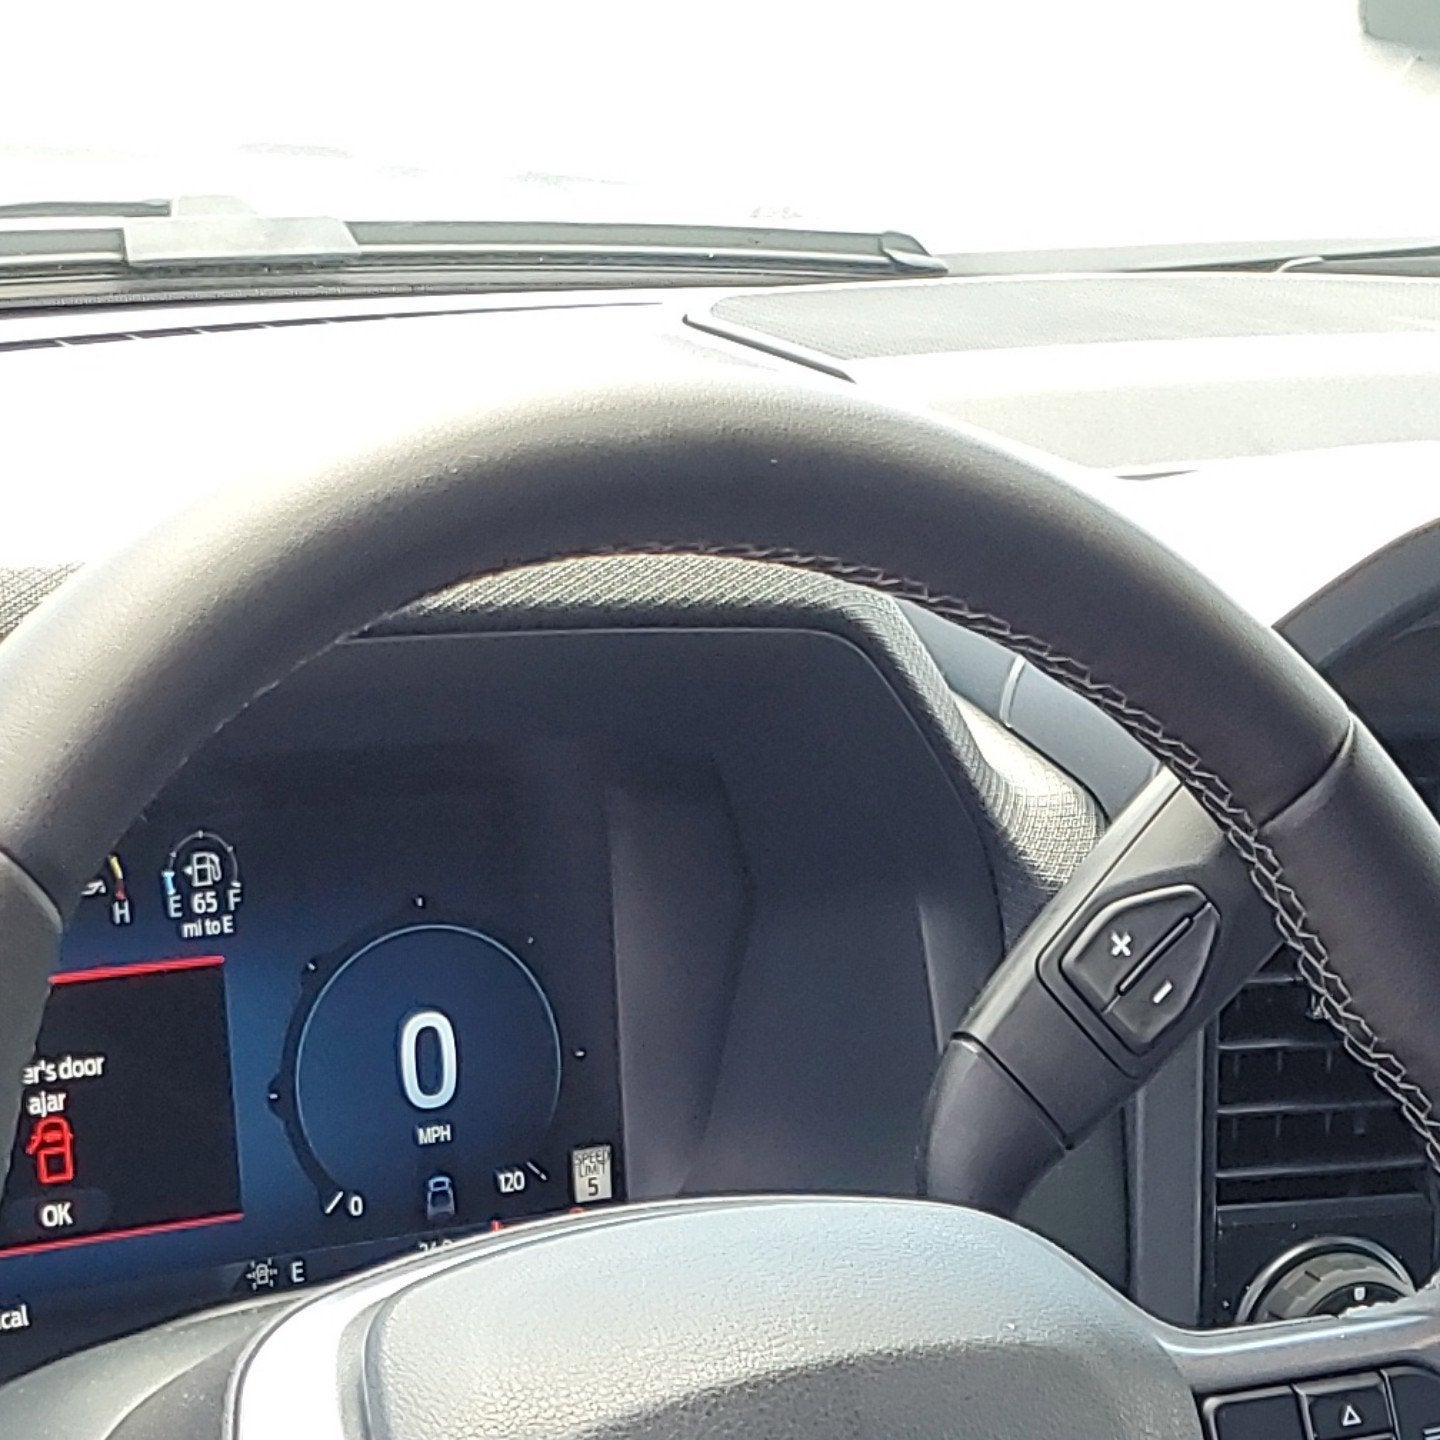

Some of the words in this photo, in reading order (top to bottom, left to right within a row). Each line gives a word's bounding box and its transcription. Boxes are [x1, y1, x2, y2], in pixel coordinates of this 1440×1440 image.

[114, 899, 131, 924] H
[170, 896, 182, 918] E
[192, 892, 218, 914] 65
[228, 889, 242, 911] F
[182, 919, 203, 938] mi
[205, 919, 221, 936] to
[223, 916, 234, 935] E
[59, 1056, 105, 1078] door
[399, 1009, 458, 1111] 0
[28, 1091, 66, 1117] ajar
[418, 1123, 452, 1146] MPH
[497, 1171, 526, 1194] 120
[588, 1176, 600, 1197] 5
[41, 1202, 73, 1228] OK
[348, 1197, 364, 1217] 0
[291, 1260, 306, 1284] E
